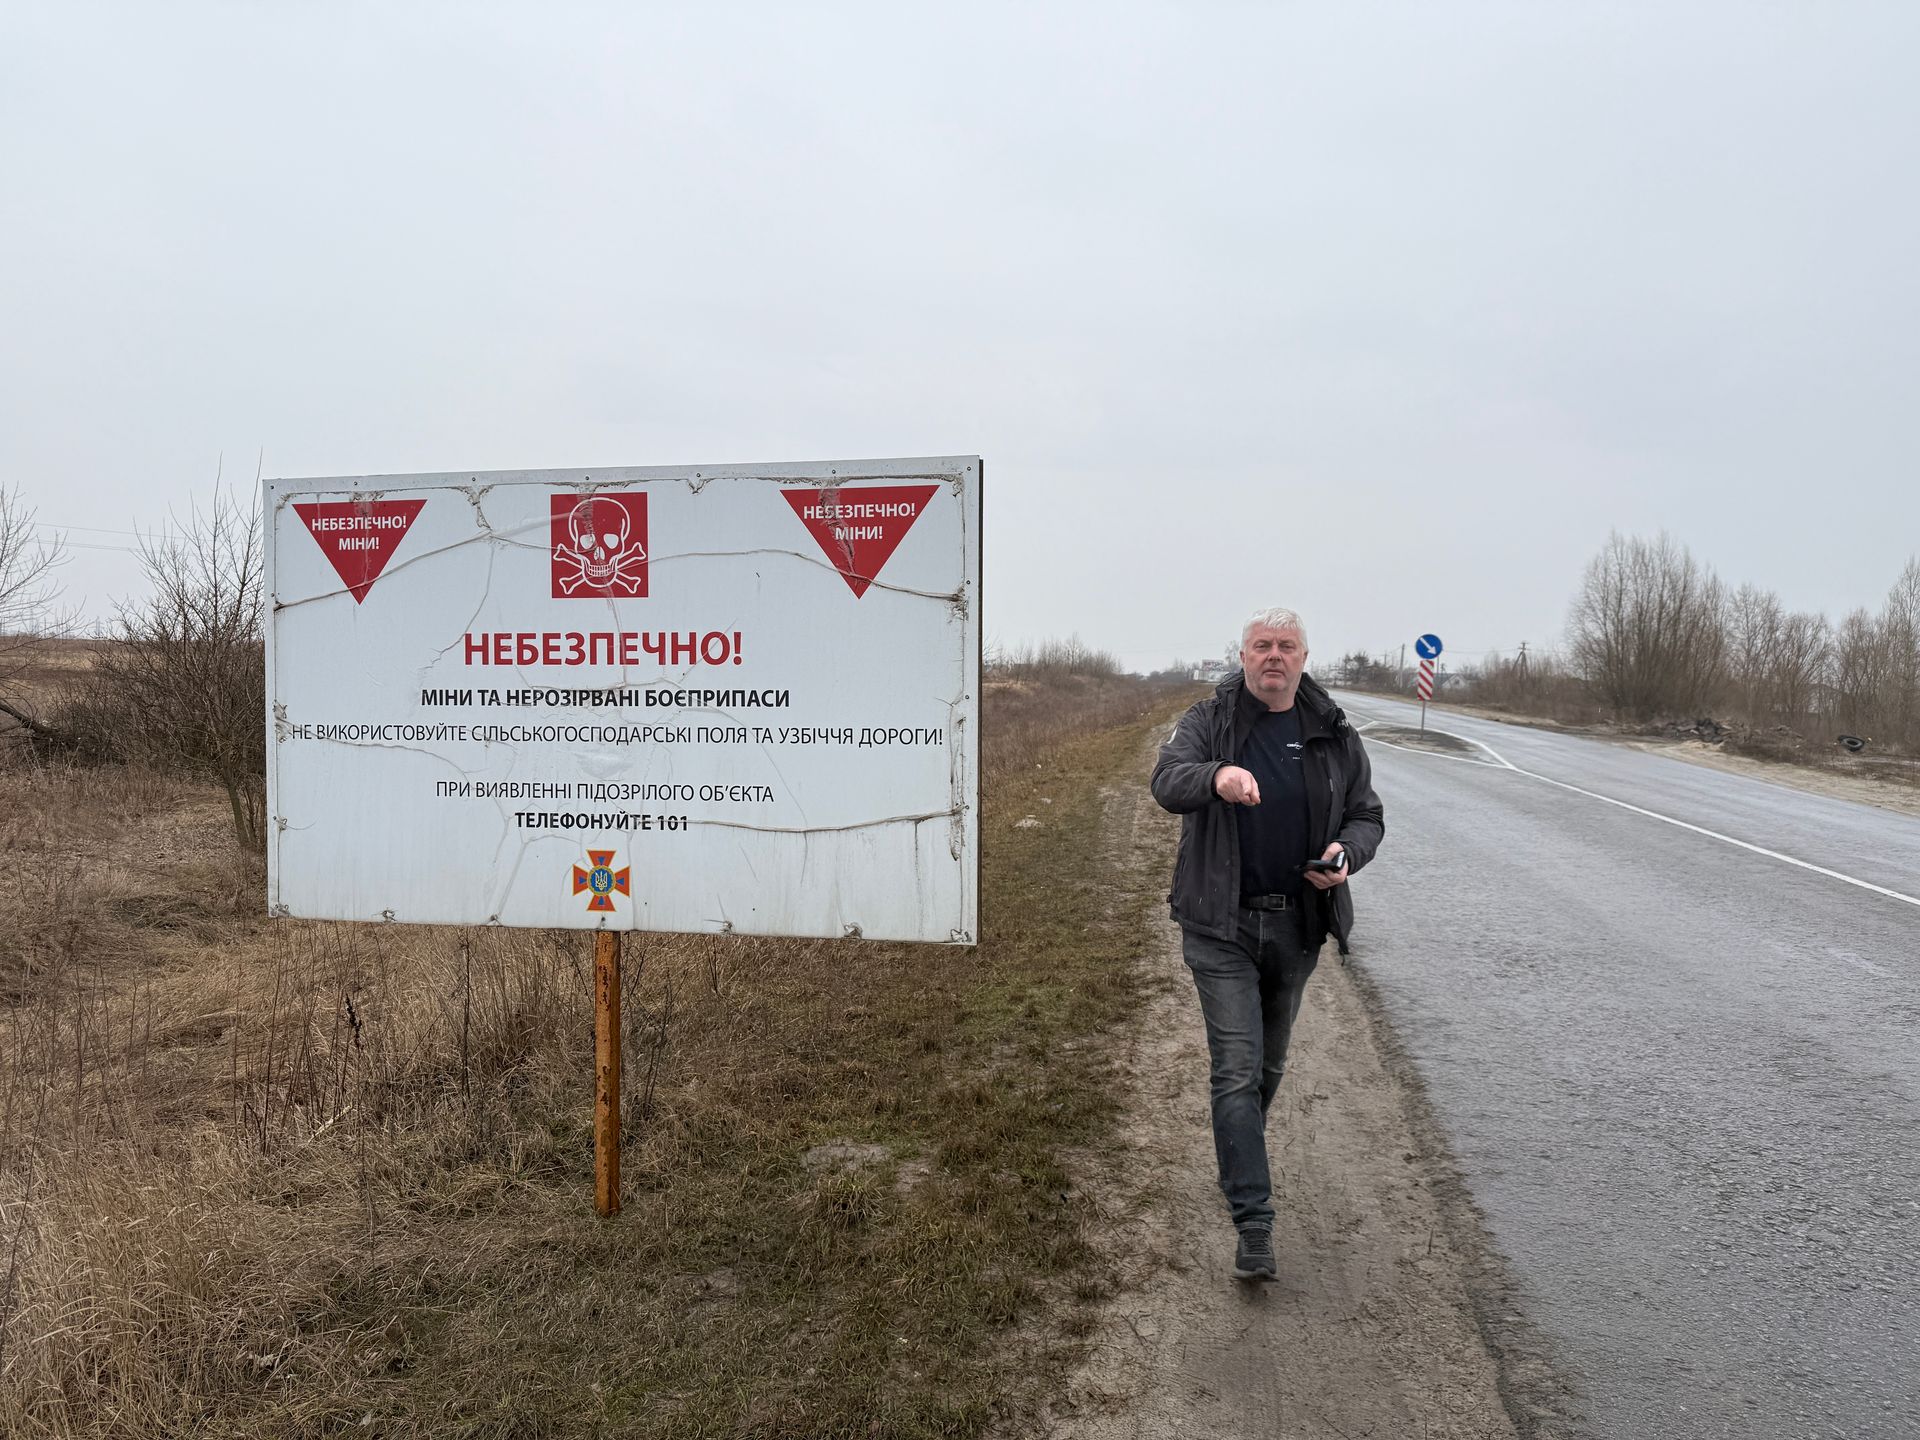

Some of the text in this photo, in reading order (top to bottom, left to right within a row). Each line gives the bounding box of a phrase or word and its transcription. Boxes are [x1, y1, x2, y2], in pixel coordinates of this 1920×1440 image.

[803, 502, 916, 520] НЕБЕЗПЕЧНО!
[312, 515, 407, 531] НЕБЕЗПЕЧНО!
[835, 526, 884, 540] МІНИ!
[339, 537, 380, 551] МІНИ!
[464, 631, 743, 666] НЕБЕЗПЕЧНО!
[421, 689, 790, 708] МІНИ ТА НЕРОЗІРВАНІ БОЄПРИПАСИ
[292, 722, 943, 748] НЕ ВИКОРИСТОВУЙТЕ СІЛЬСЬКОГОСПОДАРСЬКІ ПОЛЯ ТА УЗБІЧЧЯ ДОРОГИ!
[437, 781, 471, 797] ПРИ
[475, 782, 571, 799] ВИЯВЛЕННІ
[577, 783, 694, 802] ПІДОЗРІЛОГО
[515, 810, 689, 831] ТЕЛЕФОНУЙТЕ 101
